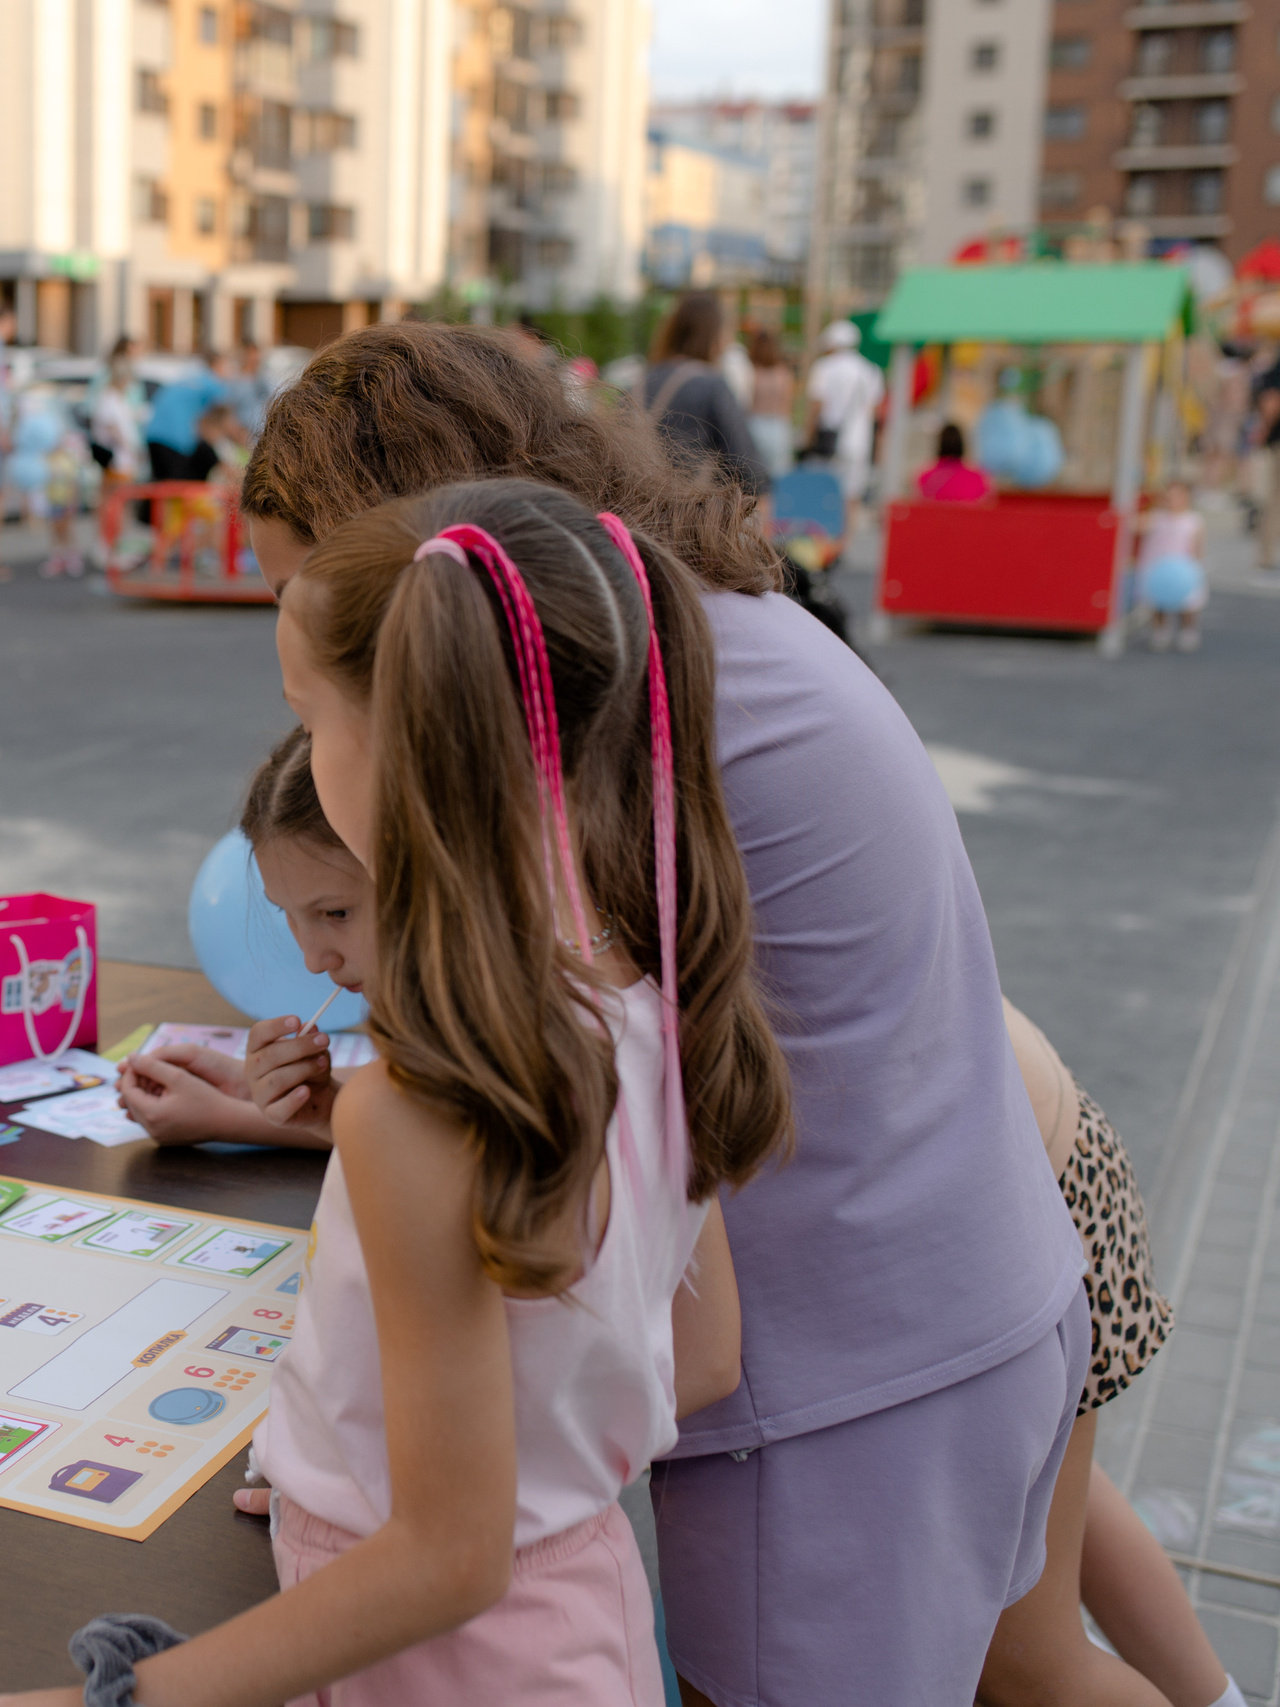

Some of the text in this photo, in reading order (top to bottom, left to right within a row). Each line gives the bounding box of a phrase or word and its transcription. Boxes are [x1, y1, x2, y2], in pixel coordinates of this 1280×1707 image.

[8, 1304, 42, 1326] НЕДЕЛЯ
[37, 1314, 72, 1327] 4
[253, 1308, 283, 1320] 8
[137, 1332, 183, 1364] КОПИЛКА
[183, 1365, 215, 1378] 6
[103, 1433, 135, 1447] 4
